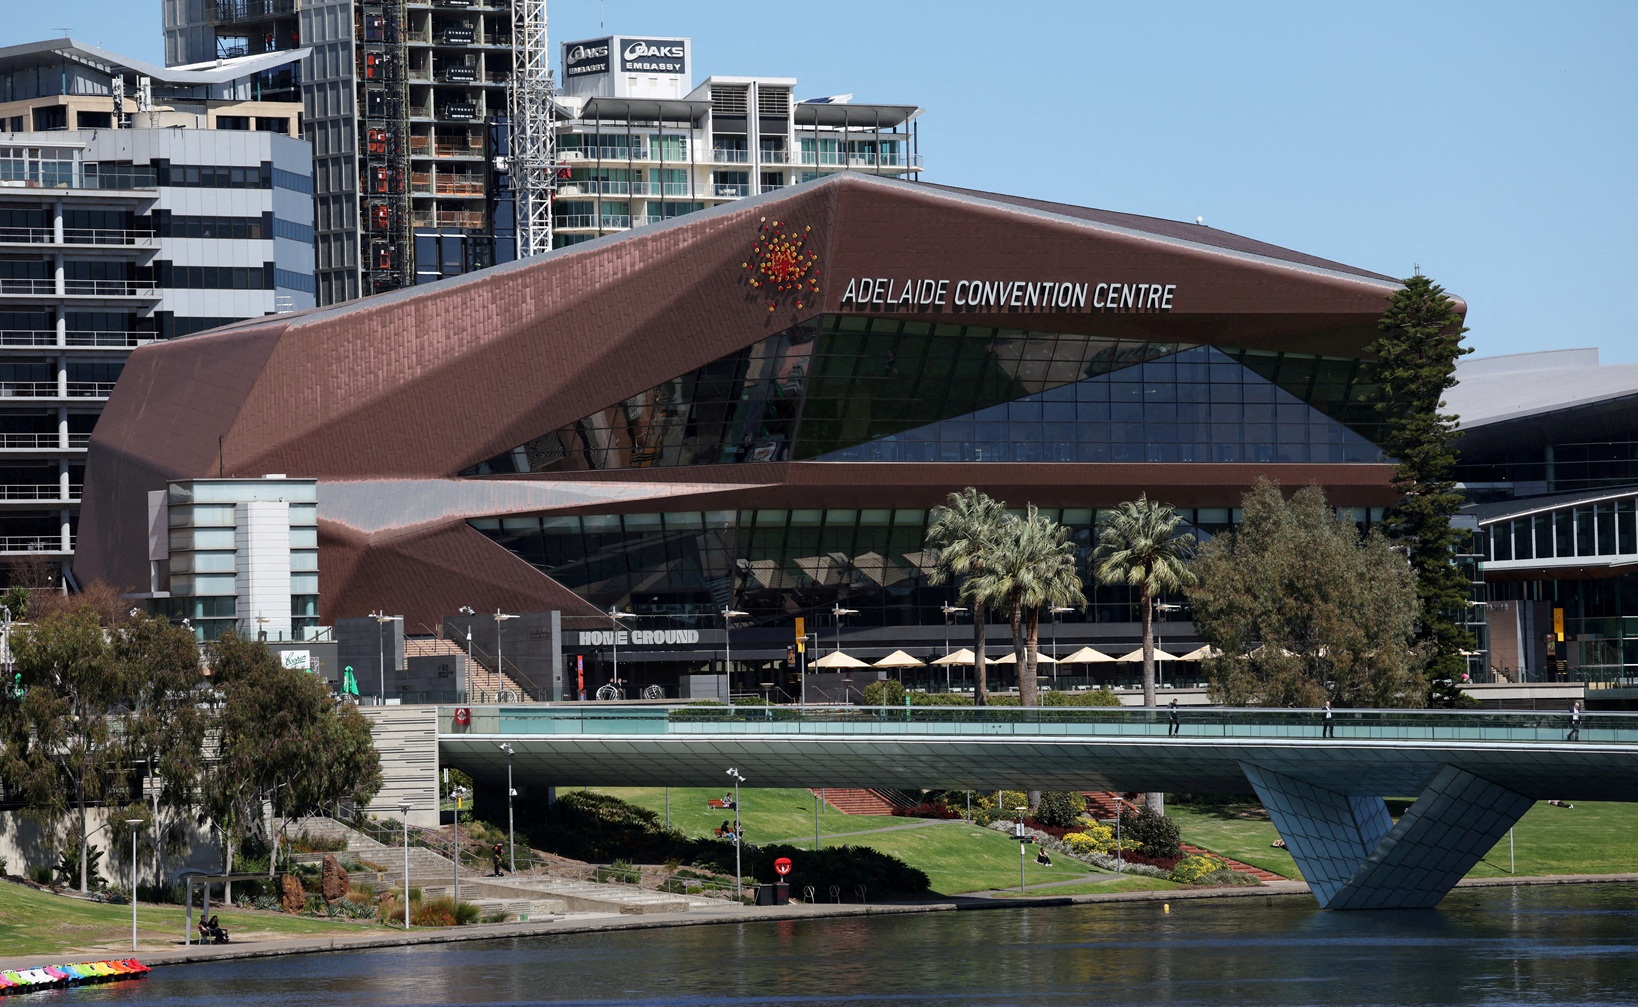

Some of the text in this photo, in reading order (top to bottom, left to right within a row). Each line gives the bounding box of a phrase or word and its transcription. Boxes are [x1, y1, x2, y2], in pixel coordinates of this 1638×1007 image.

[570, 45, 608, 62] OAKS
[629, 43, 684, 59] OAKS
[568, 63, 607, 75] EMBASSY
[626, 62, 681, 71] EMBASSY
[842, 278, 1177, 309] ADELAIDE CONVENTION CENTRE
[579, 629, 700, 646] HOME GROUND
